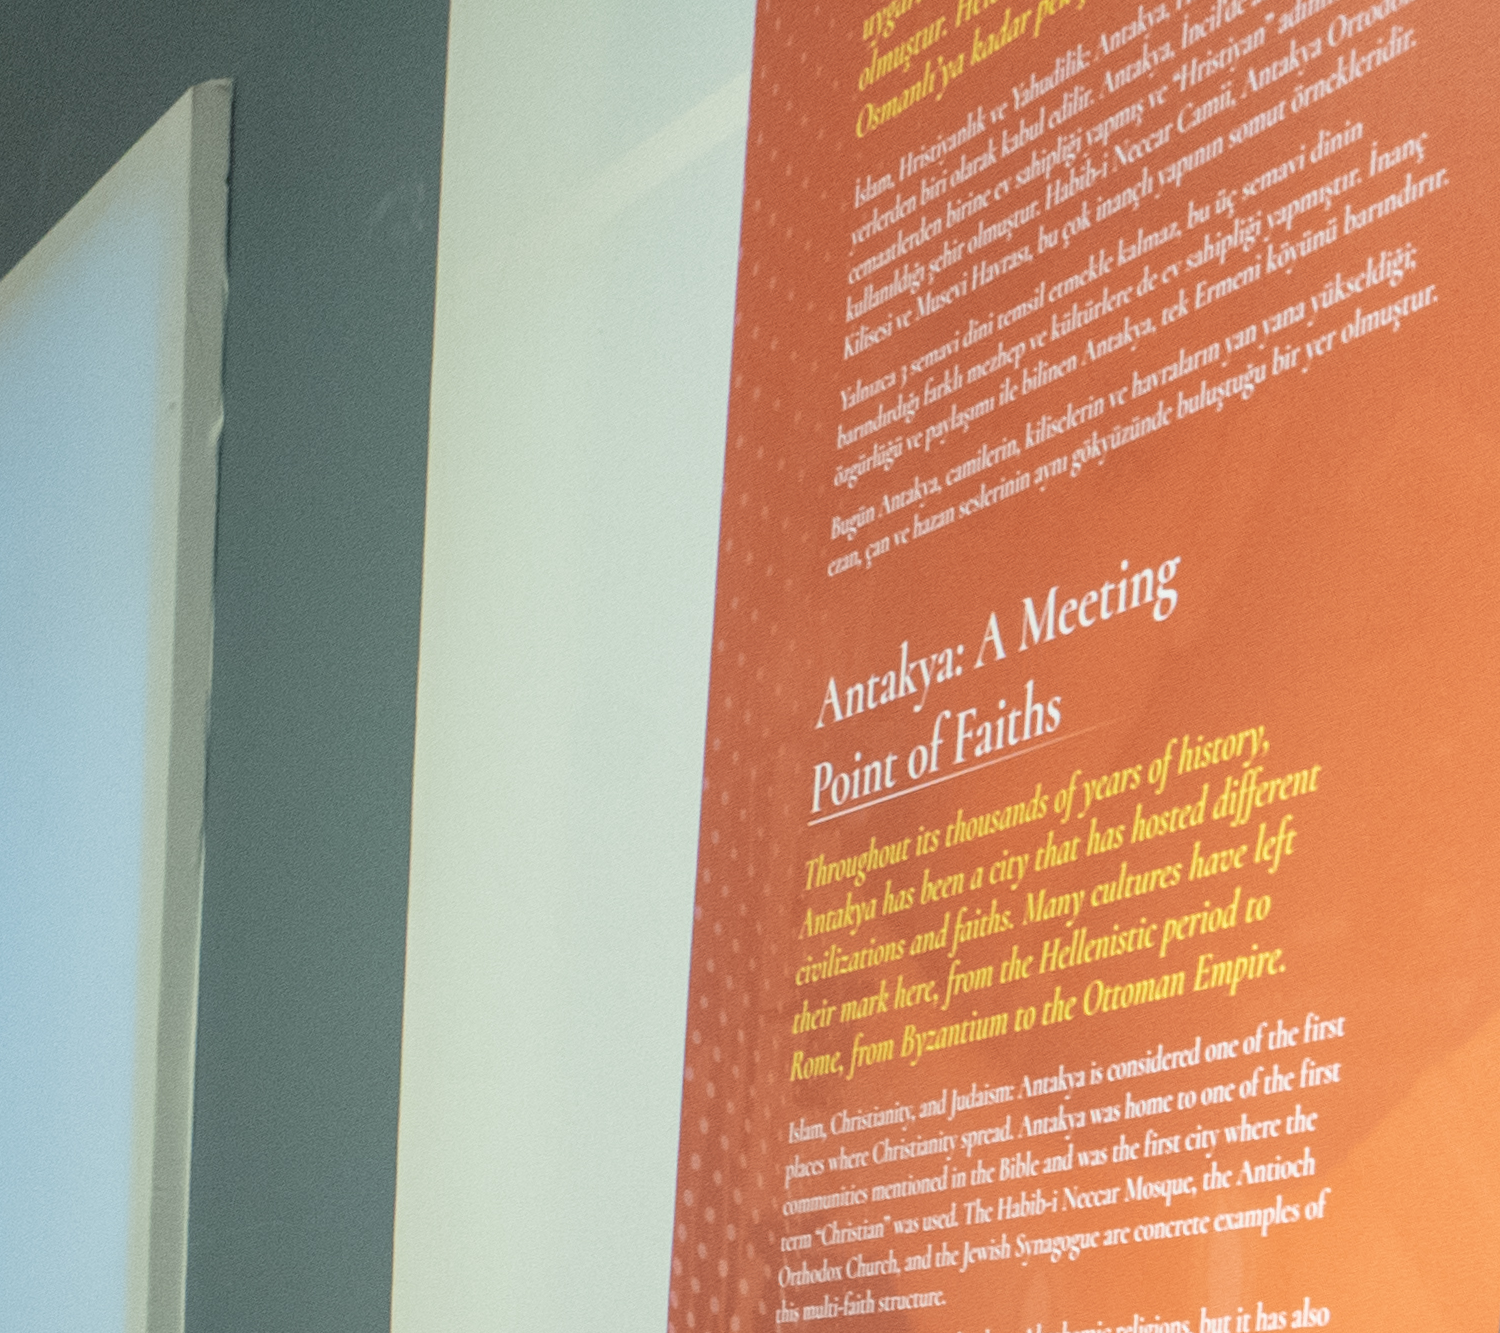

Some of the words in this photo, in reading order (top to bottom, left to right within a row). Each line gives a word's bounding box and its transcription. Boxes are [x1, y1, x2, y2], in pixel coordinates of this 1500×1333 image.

[826, 549, 862, 577] ezan,
[864, 535, 890, 569] çan
[892, 526, 911, 546] ve
[957, 469, 1031, 518] seslerinin
[1032, 454, 1068, 492] aynı
[1069, 399, 1173, 478] gökyüzünde
[1175, 362, 1267, 419] buluştuğu
[1270, 343, 1301, 376] bir
[1300, 329, 1337, 374] yer
[1339, 283, 1438, 344] olmuştur.
[815, 640, 964, 729] Antakya:
[973, 611, 1006, 669] A
[1018, 556, 1180, 651] Meeting
[805, 836, 911, 890] Throughout
[914, 824, 941, 857] its
[944, 782, 1049, 847] thousands
[1052, 768, 1082, 824] of
[1076, 763, 1143, 819] years
[1146, 736, 1178, 795] of
[1176, 724, 1270, 774] history,
[810, 751, 897, 813] Point
[906, 709, 951, 779] of
[953, 679, 1061, 764] Faiths
[794, 937, 906, 986] civilizations
[908, 911, 951, 956] and
[947, 898, 1014, 958] faiths.
[1021, 888, 1086, 928] Many
[1089, 861, 1183, 907] cultures
[1187, 840, 1248, 881] have
[1253, 814, 1297, 874] left
[798, 892, 877, 939] Antakya
[881, 879, 915, 915] has
[919, 868, 965, 905] been
[968, 865, 984, 891] a
[987, 848, 1030, 891] city
[1033, 830, 1081, 872] that
[1085, 817, 1126, 856] has
[1130, 784, 1209, 843] hosted
[1211, 764, 1321, 827] different
[788, 1049, 844, 1082] Rome,
[845, 1032, 895, 1080] from
[900, 1010, 1009, 1066] Byzantium
[1013, 1005, 1037, 1032] to
[1040, 985, 1077, 1026] the
[1081, 970, 1186, 1016] Ottoman
[1192, 943, 1286, 996] Empire.
[791, 998, 837, 1035] their
[839, 978, 890, 1023] mark
[892, 974, 939, 1009] here,
[940, 959, 994, 1011] from
[998, 944, 1034, 984] the
[1038, 916, 1157, 974] Hellenistic
[1158, 886, 1242, 958] period
[1243, 894, 1272, 924] to
